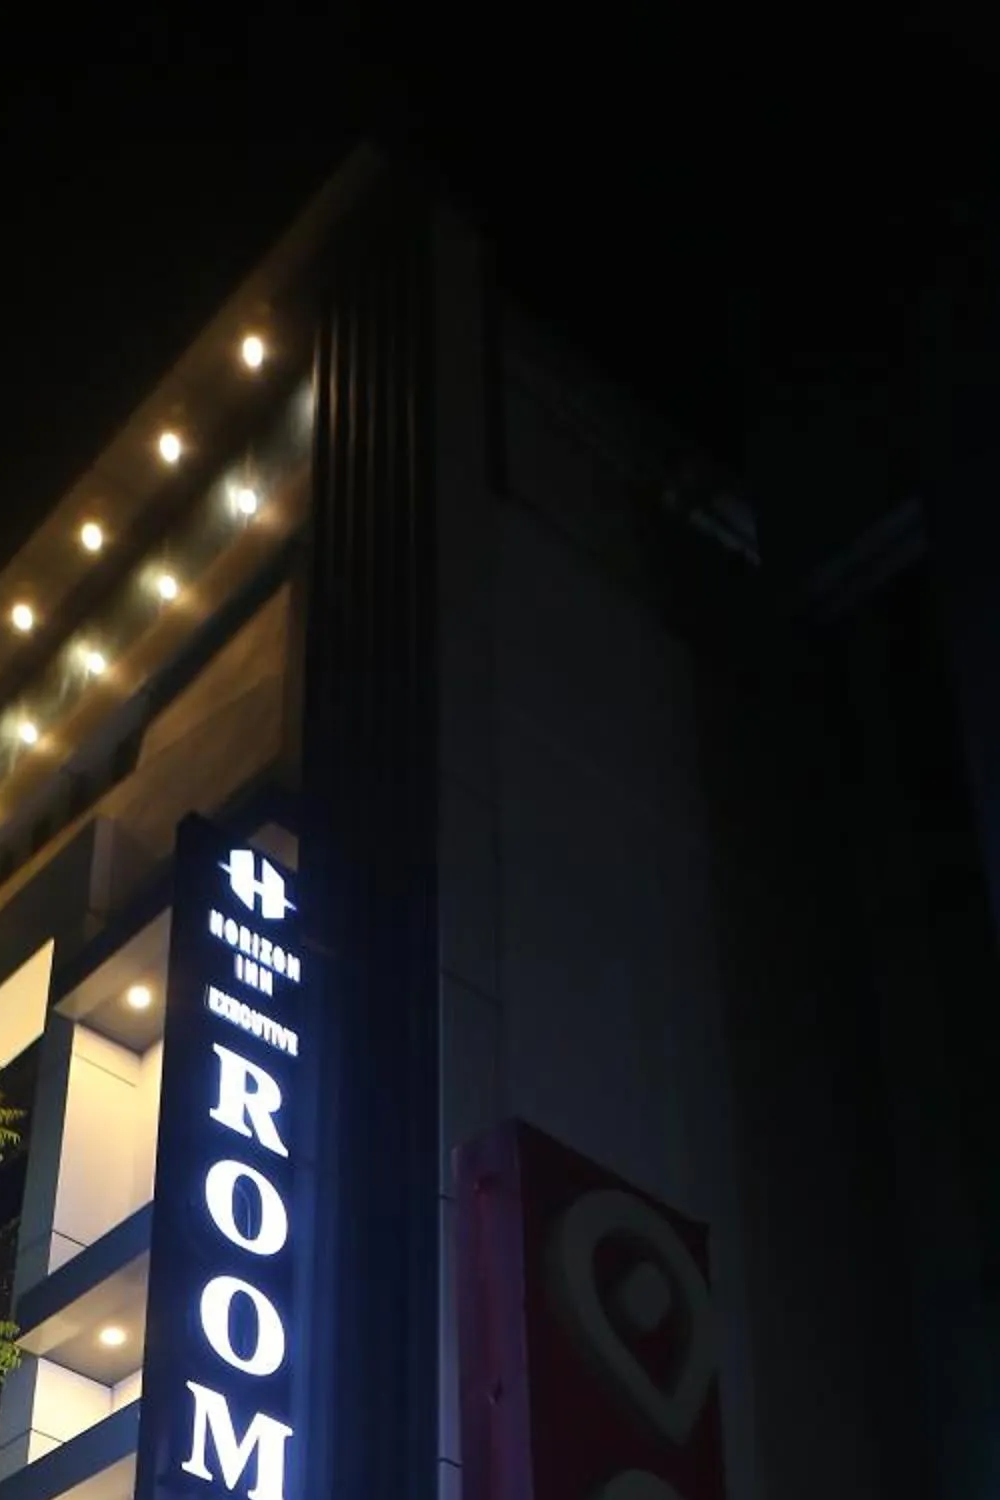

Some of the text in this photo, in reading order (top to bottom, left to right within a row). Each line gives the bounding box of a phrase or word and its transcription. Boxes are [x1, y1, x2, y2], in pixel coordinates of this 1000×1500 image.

[208, 908, 301, 983] HORIZON
[234, 953, 274, 997] INN
[208, 984, 299, 1057] EXECUTIVE
